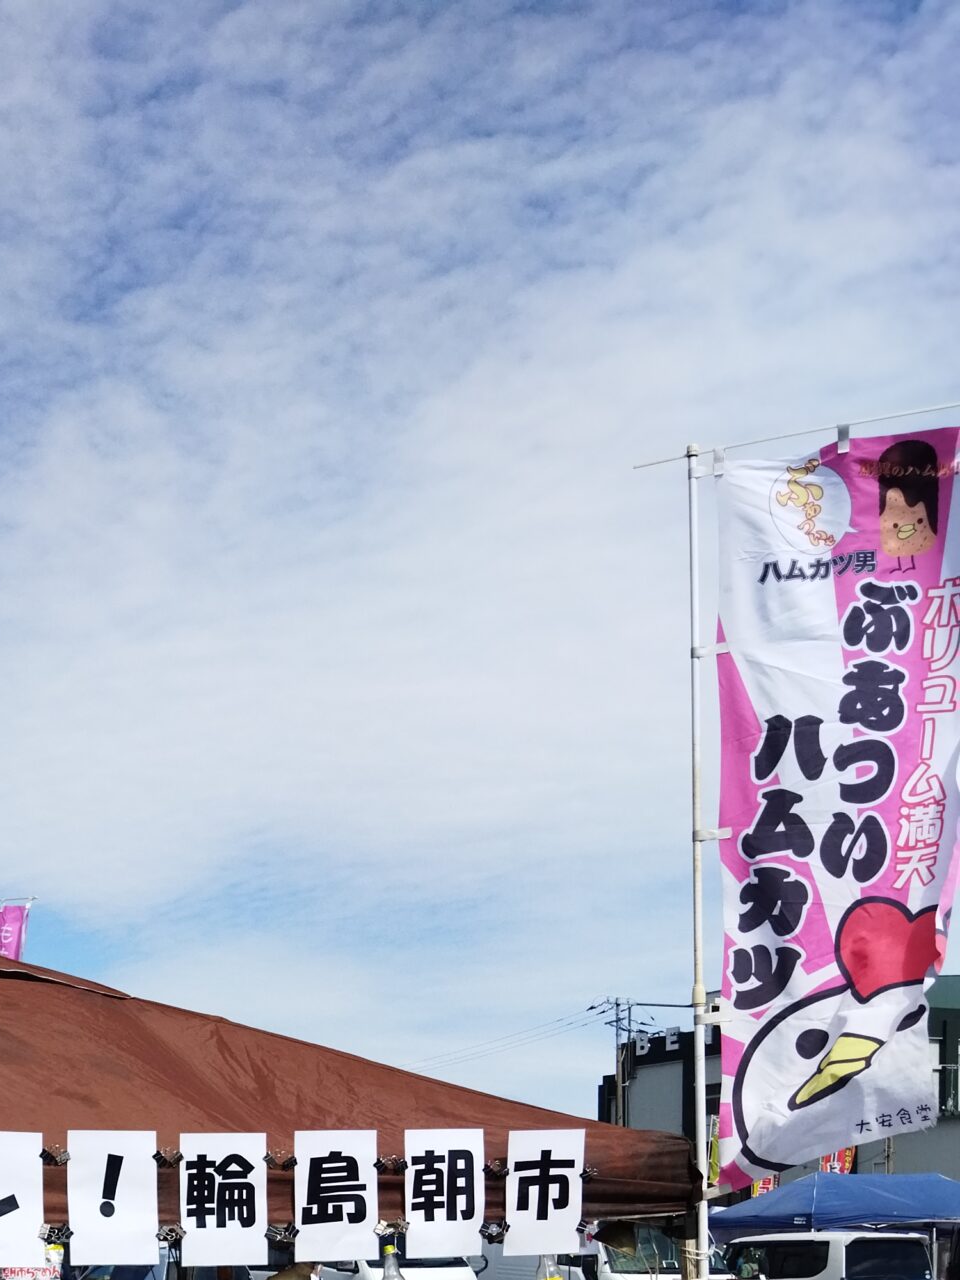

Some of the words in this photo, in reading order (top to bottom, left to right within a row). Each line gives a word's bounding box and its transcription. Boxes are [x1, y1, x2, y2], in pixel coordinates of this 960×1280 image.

[757, 549, 877, 585] ハムカツ男
[819, 581, 919, 884] ぶあつい
[730, 713, 829, 1011] ハムカツ
[855, 1105, 933, 1134] 大安食堂
